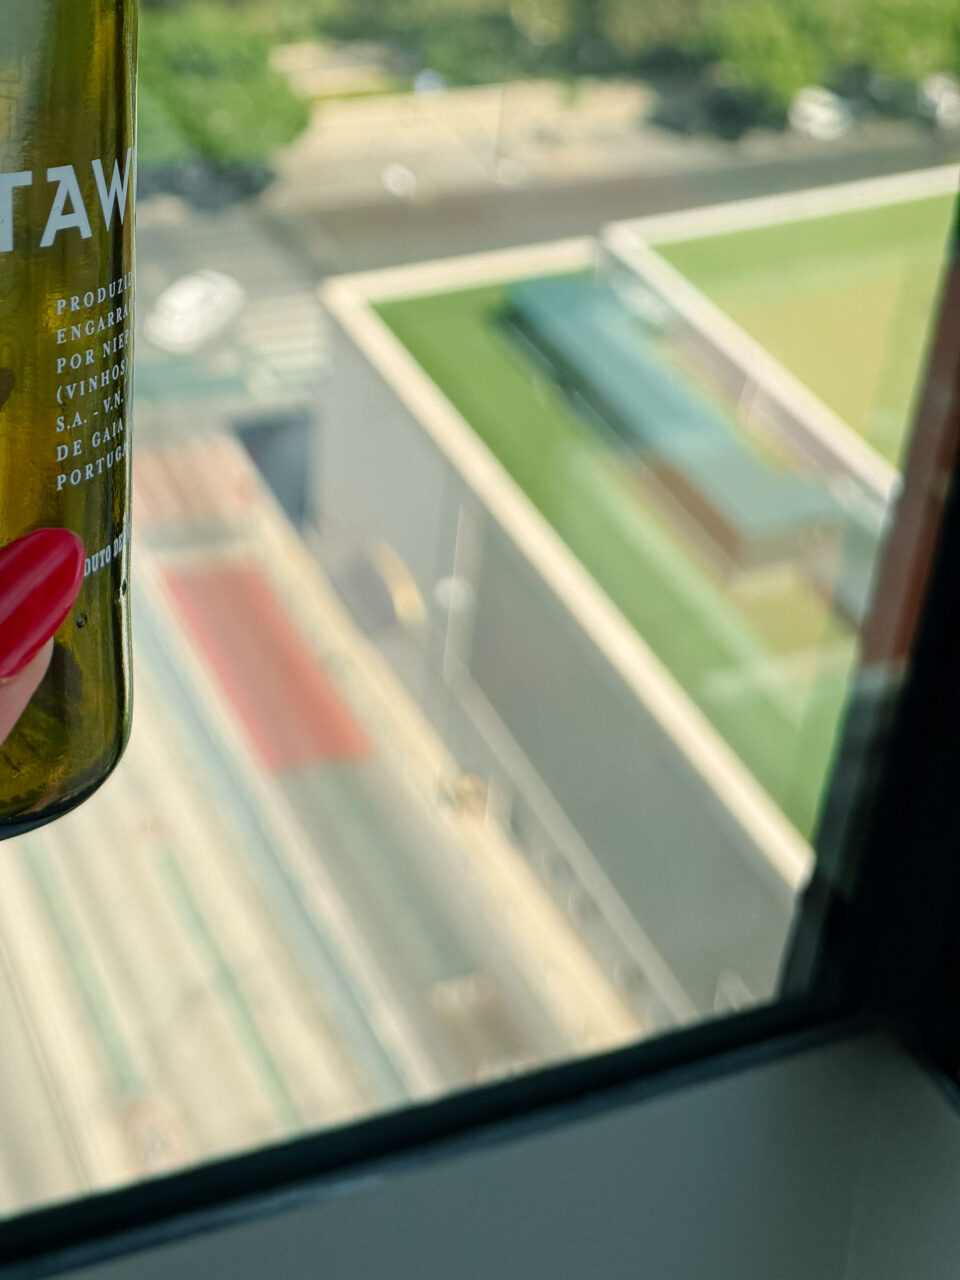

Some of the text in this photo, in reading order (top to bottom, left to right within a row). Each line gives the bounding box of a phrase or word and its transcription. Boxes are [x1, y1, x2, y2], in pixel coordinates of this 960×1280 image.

[56, 303, 129, 344] ENGARRA
[56, 349, 94, 373] POR
[56, 412, 87, 432] S.A.
[103, 391, 124, 414] V.N.
[56, 417, 123, 462] DE GAIA
[84, 544, 111, 577] DUTO
